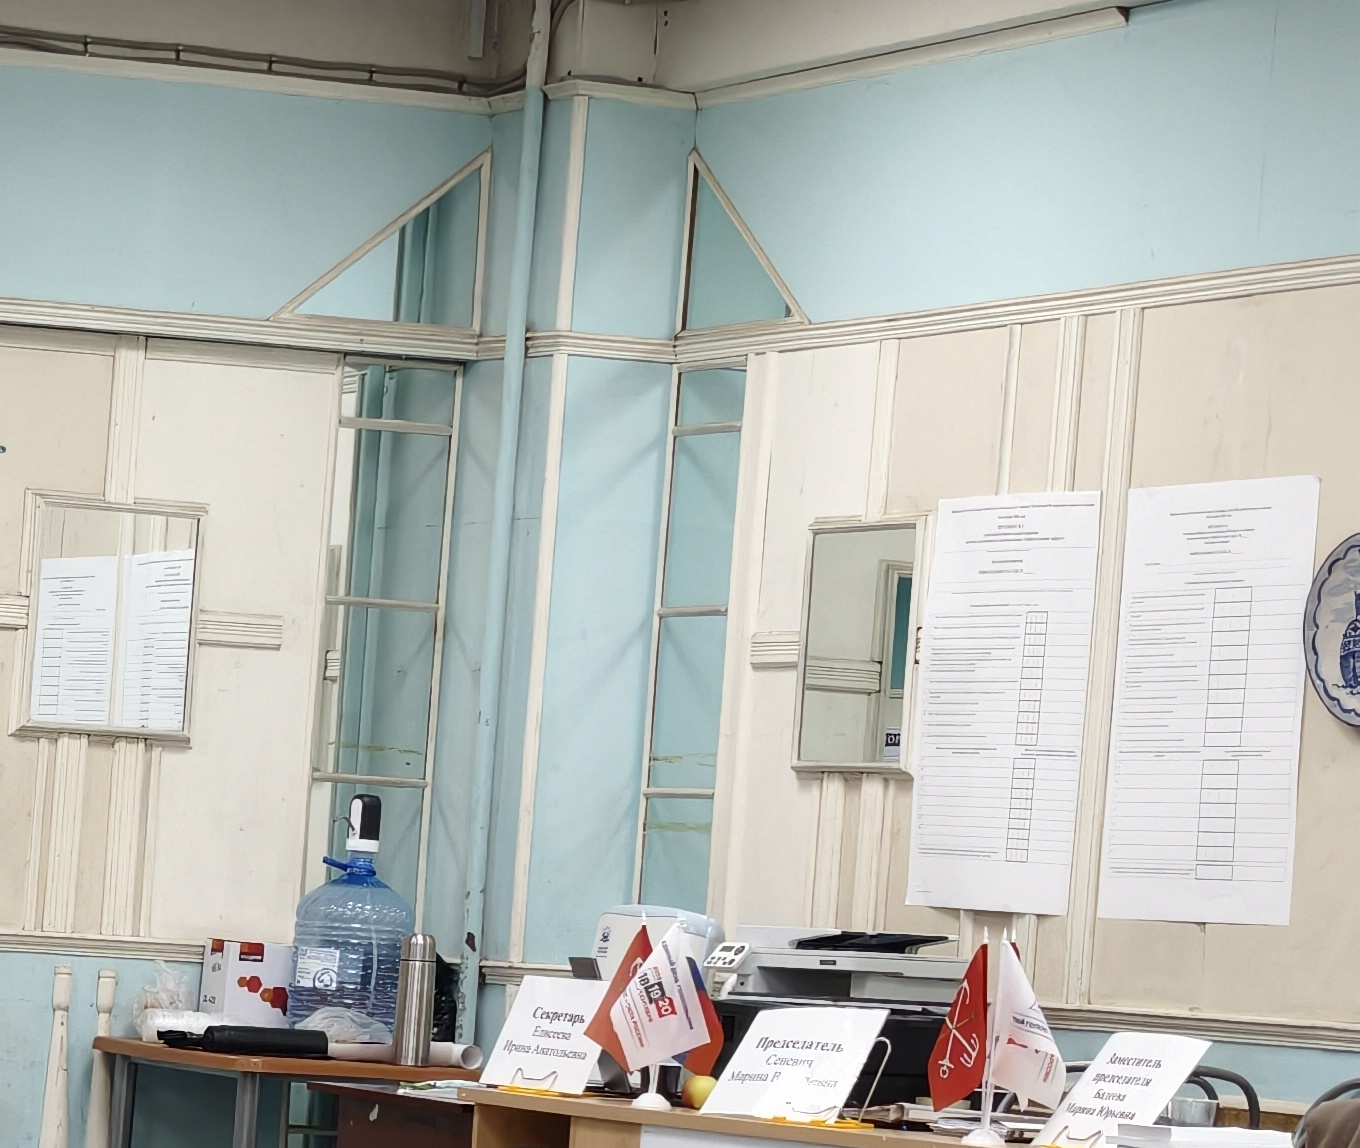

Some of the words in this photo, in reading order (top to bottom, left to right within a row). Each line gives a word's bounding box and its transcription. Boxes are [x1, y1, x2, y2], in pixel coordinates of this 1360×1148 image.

[647, 984, 662, 999] 19
[658, 997, 672, 1016] 20
[532, 1006, 585, 1027] Секретарь
[755, 1036, 844, 1053] Председатель
